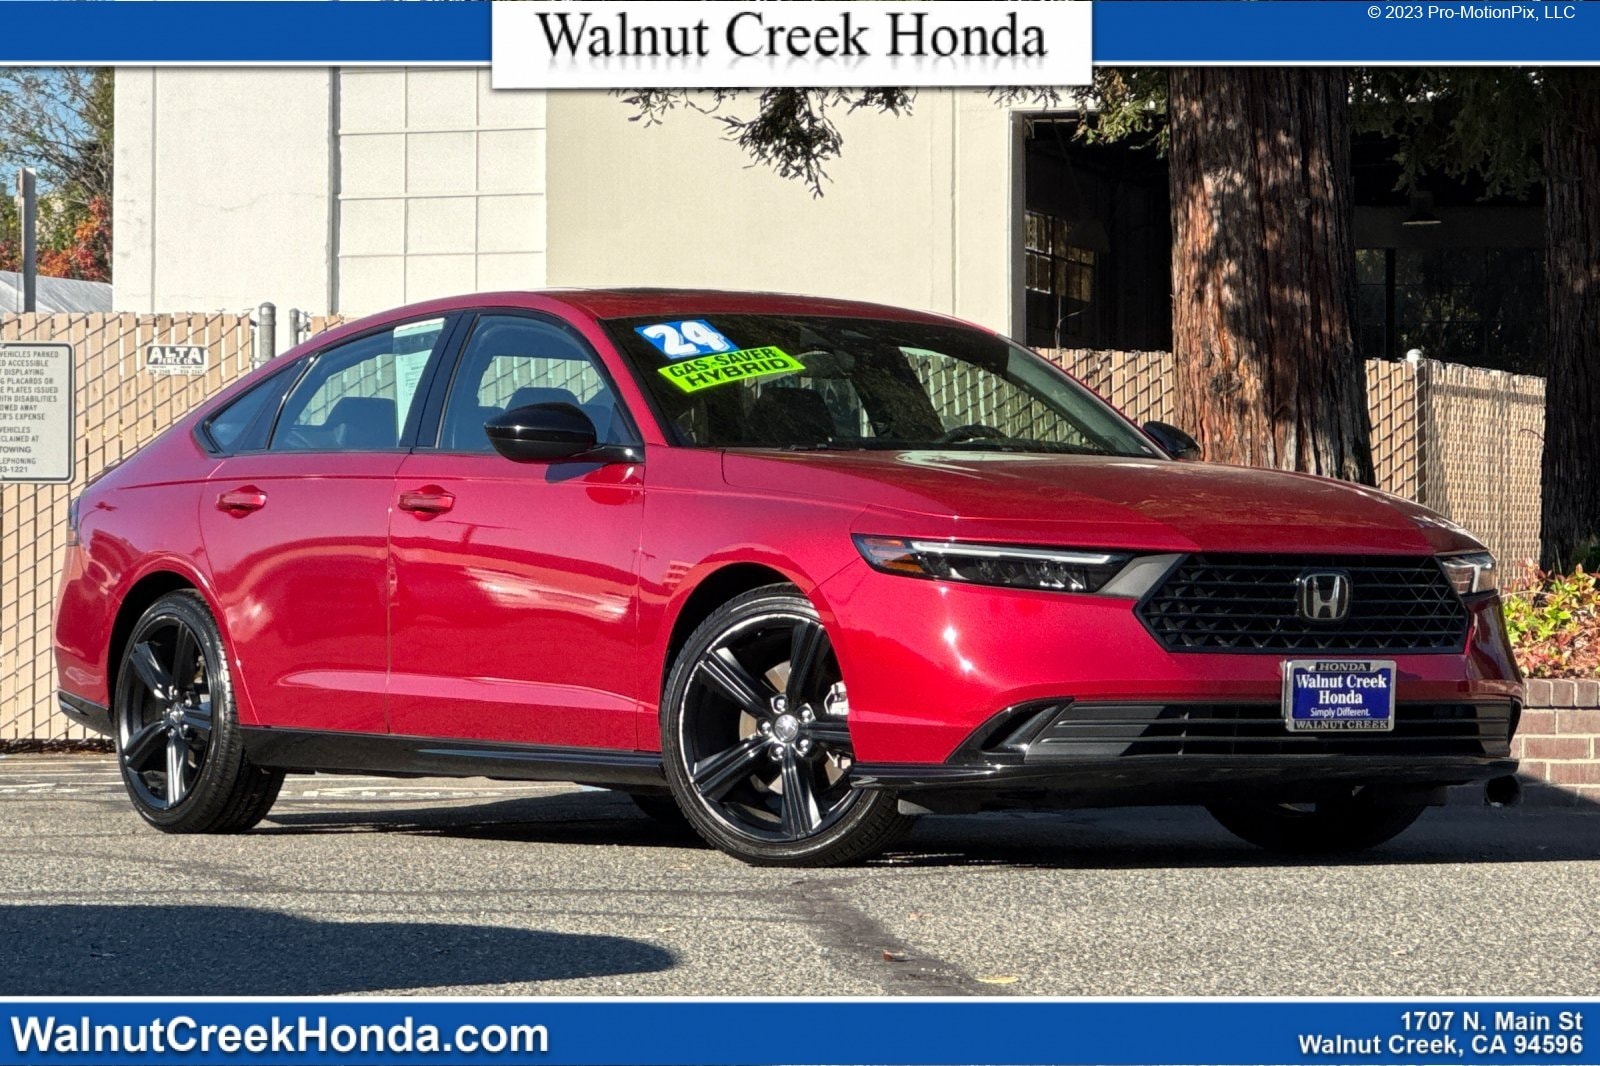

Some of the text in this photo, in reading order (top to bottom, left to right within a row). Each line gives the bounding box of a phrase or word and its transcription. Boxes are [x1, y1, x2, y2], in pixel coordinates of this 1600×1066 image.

[642, 321, 730, 357] 24
[0, 350, 59, 358] VEHICLES PARKED
[148, 346, 203, 364] ALTA
[8, 359, 49, 367] ACCESSIBLE
[668, 347, 777, 378] GAS-SAVER
[4, 368, 44, 376] DISPLAYING
[685, 357, 792, 387] HYBRID
[7, 377, 42, 385] PLACARDS
[44, 377, 54, 385] OR
[7, 386, 32, 394] PLATES
[34, 386, 59, 394] ISSUED
[0, 395, 57, 403] ITH DISABILITIES
[1319, 663, 1367, 671] HONDA
[1296, 674, 1387, 689] Walnut Creek
[1319, 690, 1363, 704] Honda
[1310, 707, 1335, 718] Simply
[1295, 720, 1388, 729] WALNUT CREEK
